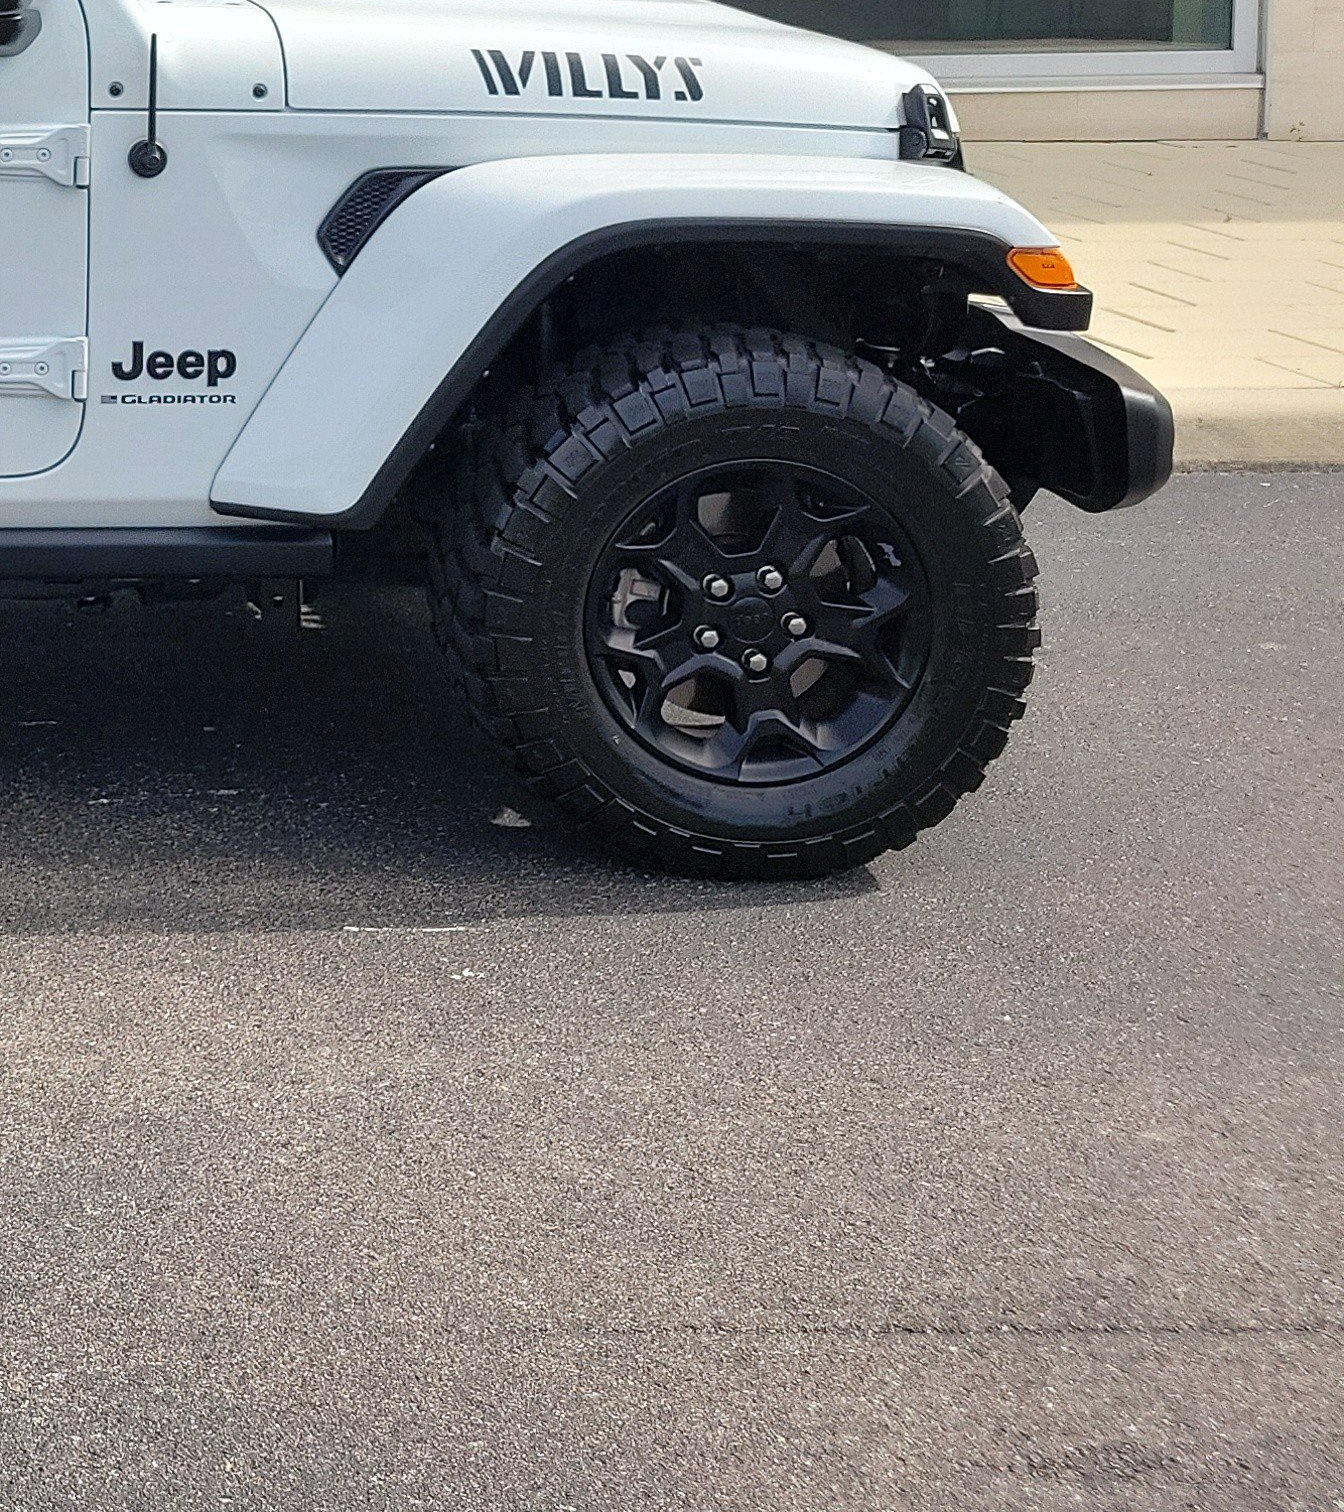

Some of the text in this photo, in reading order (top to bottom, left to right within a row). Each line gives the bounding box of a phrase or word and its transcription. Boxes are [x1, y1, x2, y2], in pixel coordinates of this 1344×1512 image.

[470, 49, 704, 102] WILLYS
[111, 341, 237, 387] Jeep
[121, 394, 237, 404] GLADIATOR
